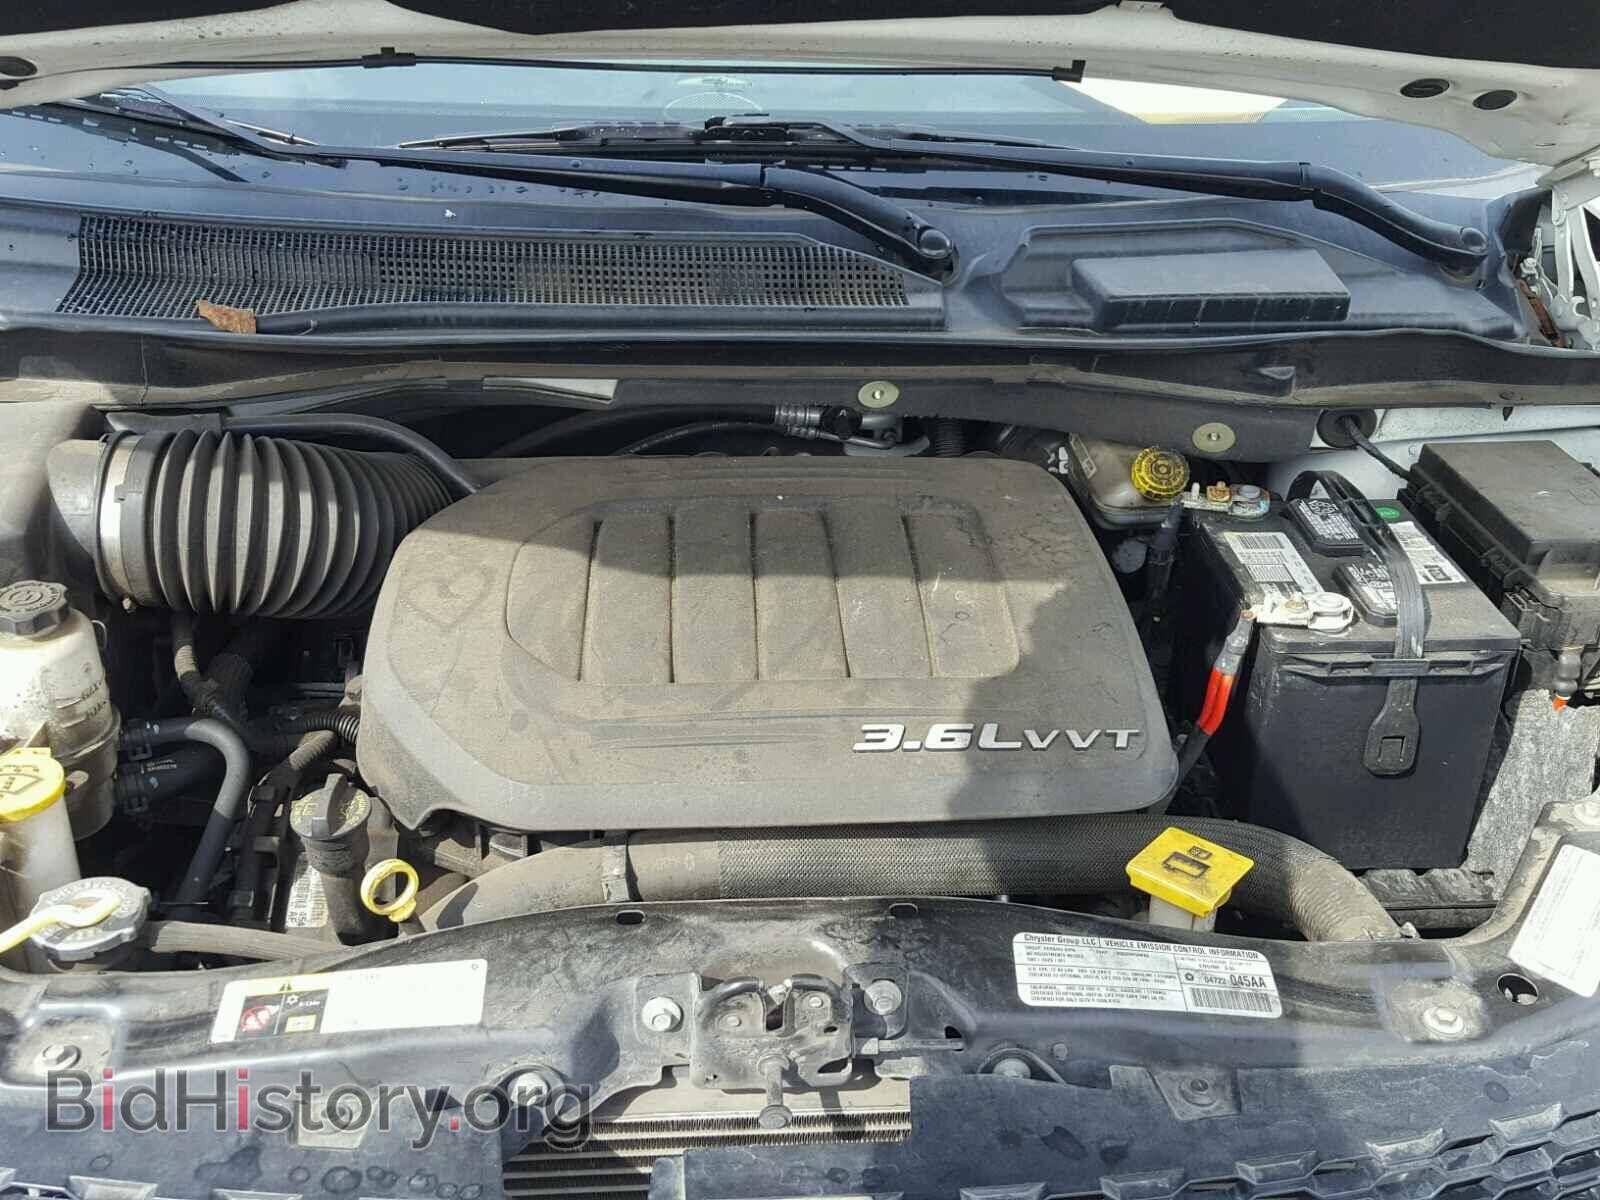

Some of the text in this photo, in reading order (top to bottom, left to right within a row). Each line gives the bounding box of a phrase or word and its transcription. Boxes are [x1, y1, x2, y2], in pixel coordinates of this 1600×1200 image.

[1024, 933, 1259, 959] Chrysler Group LLC VEHICLE EMISSION CONTROL INFORMATION
[1230, 974, 1267, 988] 045AA
